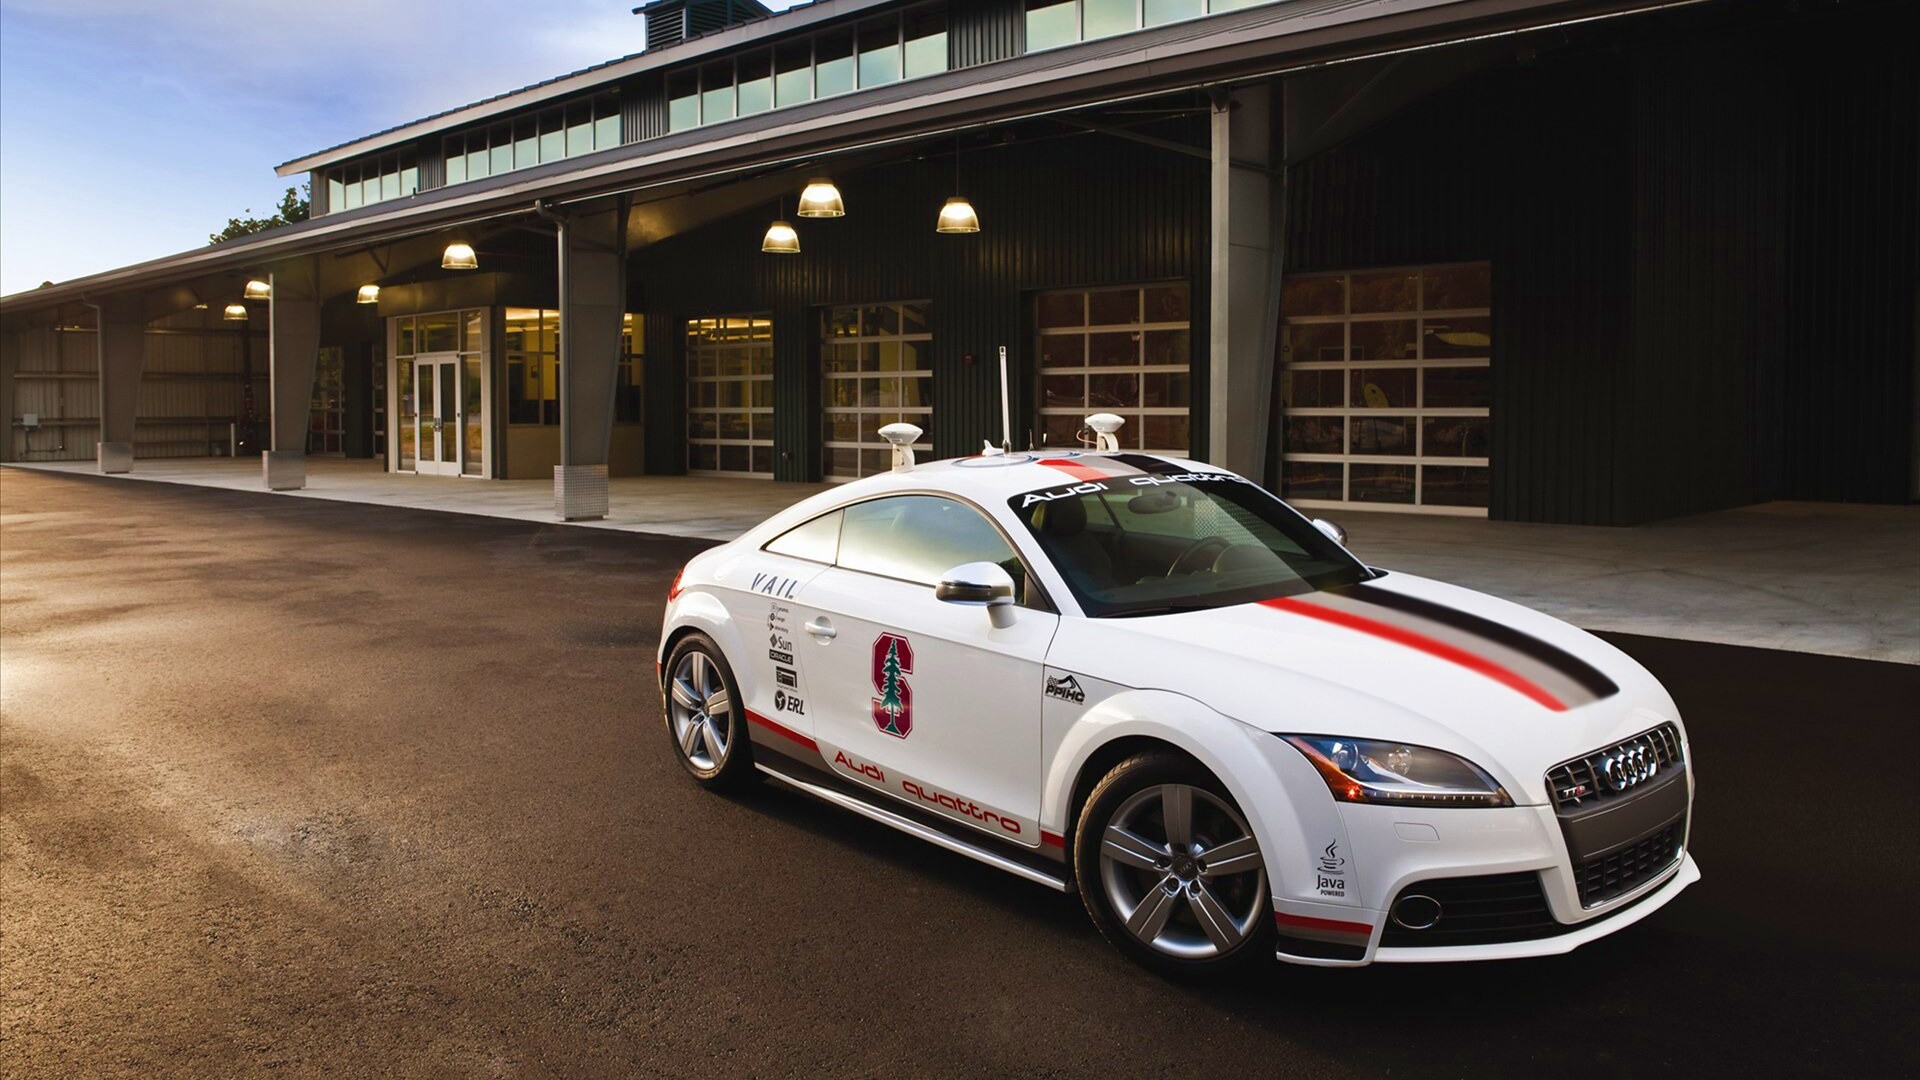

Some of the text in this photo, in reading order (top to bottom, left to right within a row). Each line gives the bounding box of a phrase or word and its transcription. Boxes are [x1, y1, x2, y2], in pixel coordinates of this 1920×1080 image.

[1022, 482, 1109, 508] Audi
[750, 572, 798, 600] VAIL
[778, 635, 793, 651] Sun
[770, 650, 793, 664] ORACLE
[1045, 684, 1085, 703] PPIHC
[786, 695, 805, 716] ERL
[834, 751, 1021, 835] Audi quattro
[1316, 874, 1345, 890] Java
